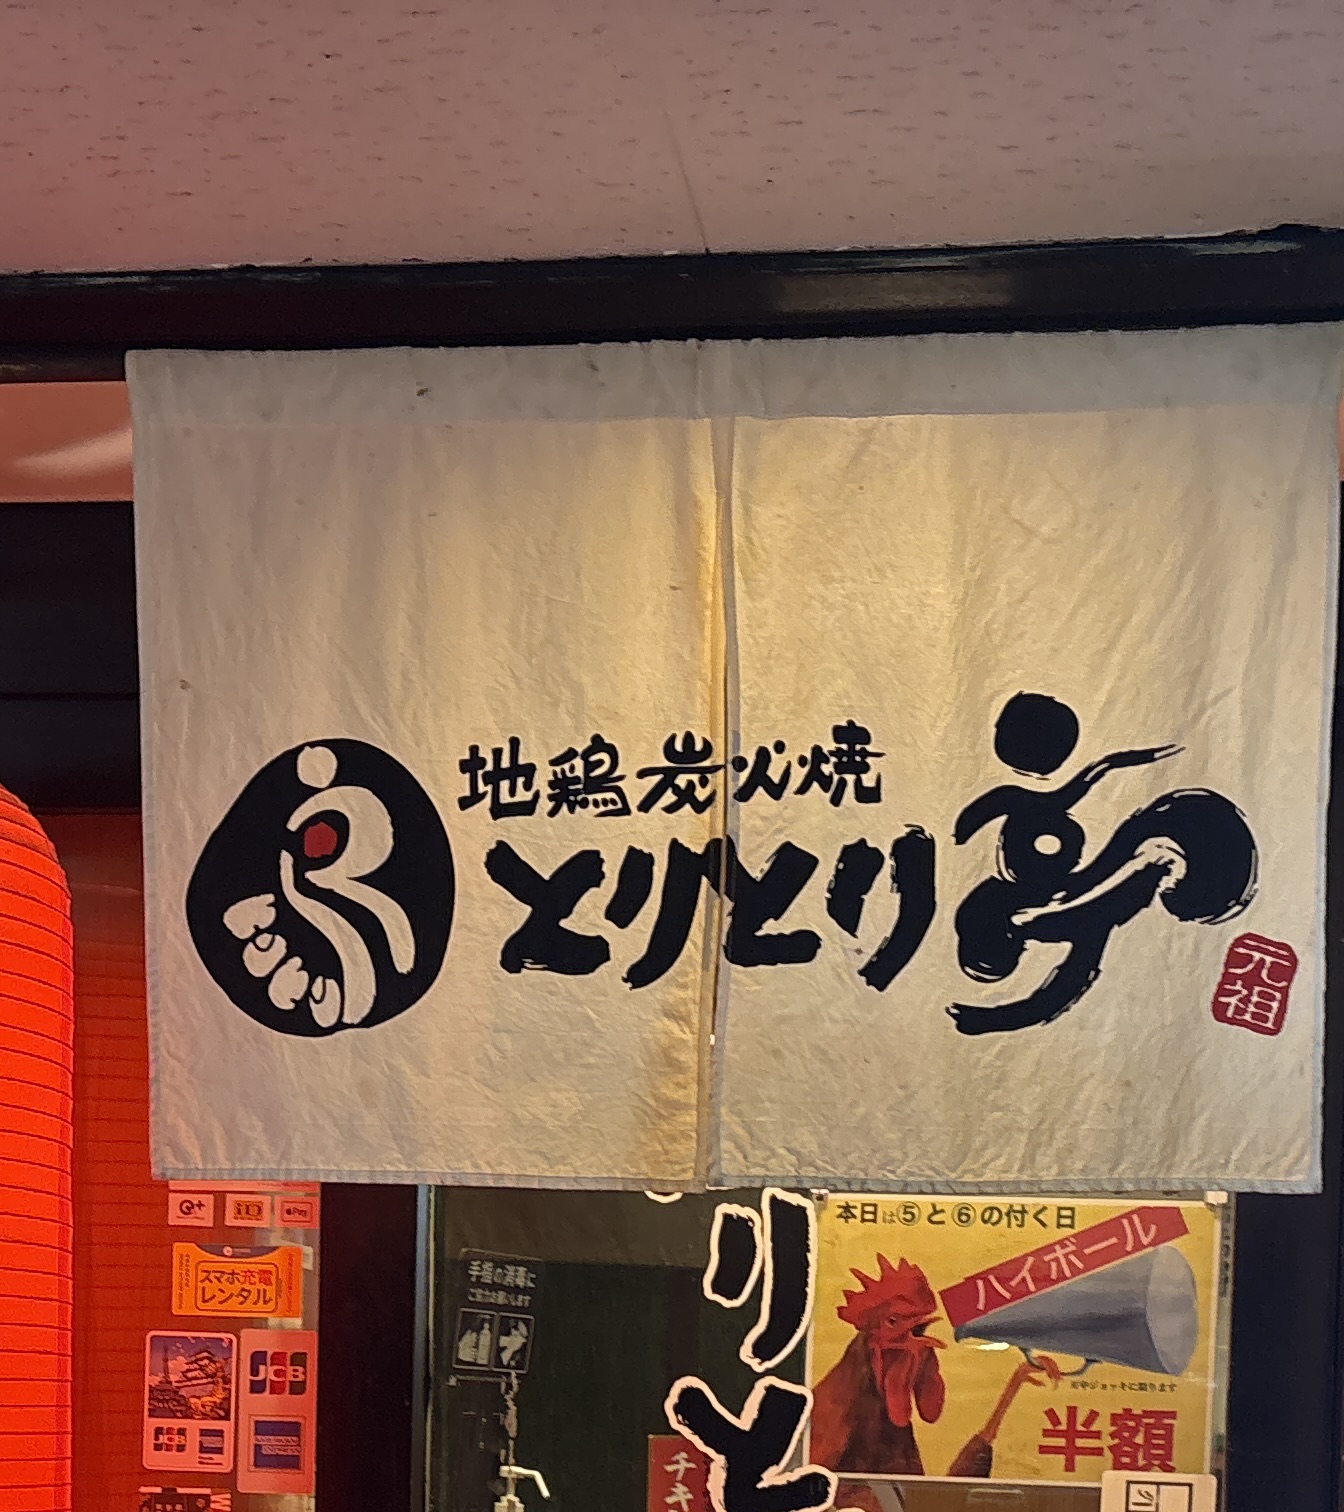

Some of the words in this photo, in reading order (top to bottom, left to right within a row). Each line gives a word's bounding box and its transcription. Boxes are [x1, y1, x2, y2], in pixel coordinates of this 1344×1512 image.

[456, 719, 886, 820] 地鶏炭火焼
[1215, 941, 1296, 1032] 元祖
[199, 1269, 273, 1287] スマホ充電
[200, 1286, 273, 1306] レンタル
[976, 1216, 1156, 1311] ハイボール
[249, 1365, 306, 1381] JCB
[1038, 1405, 1177, 1473] 半額
